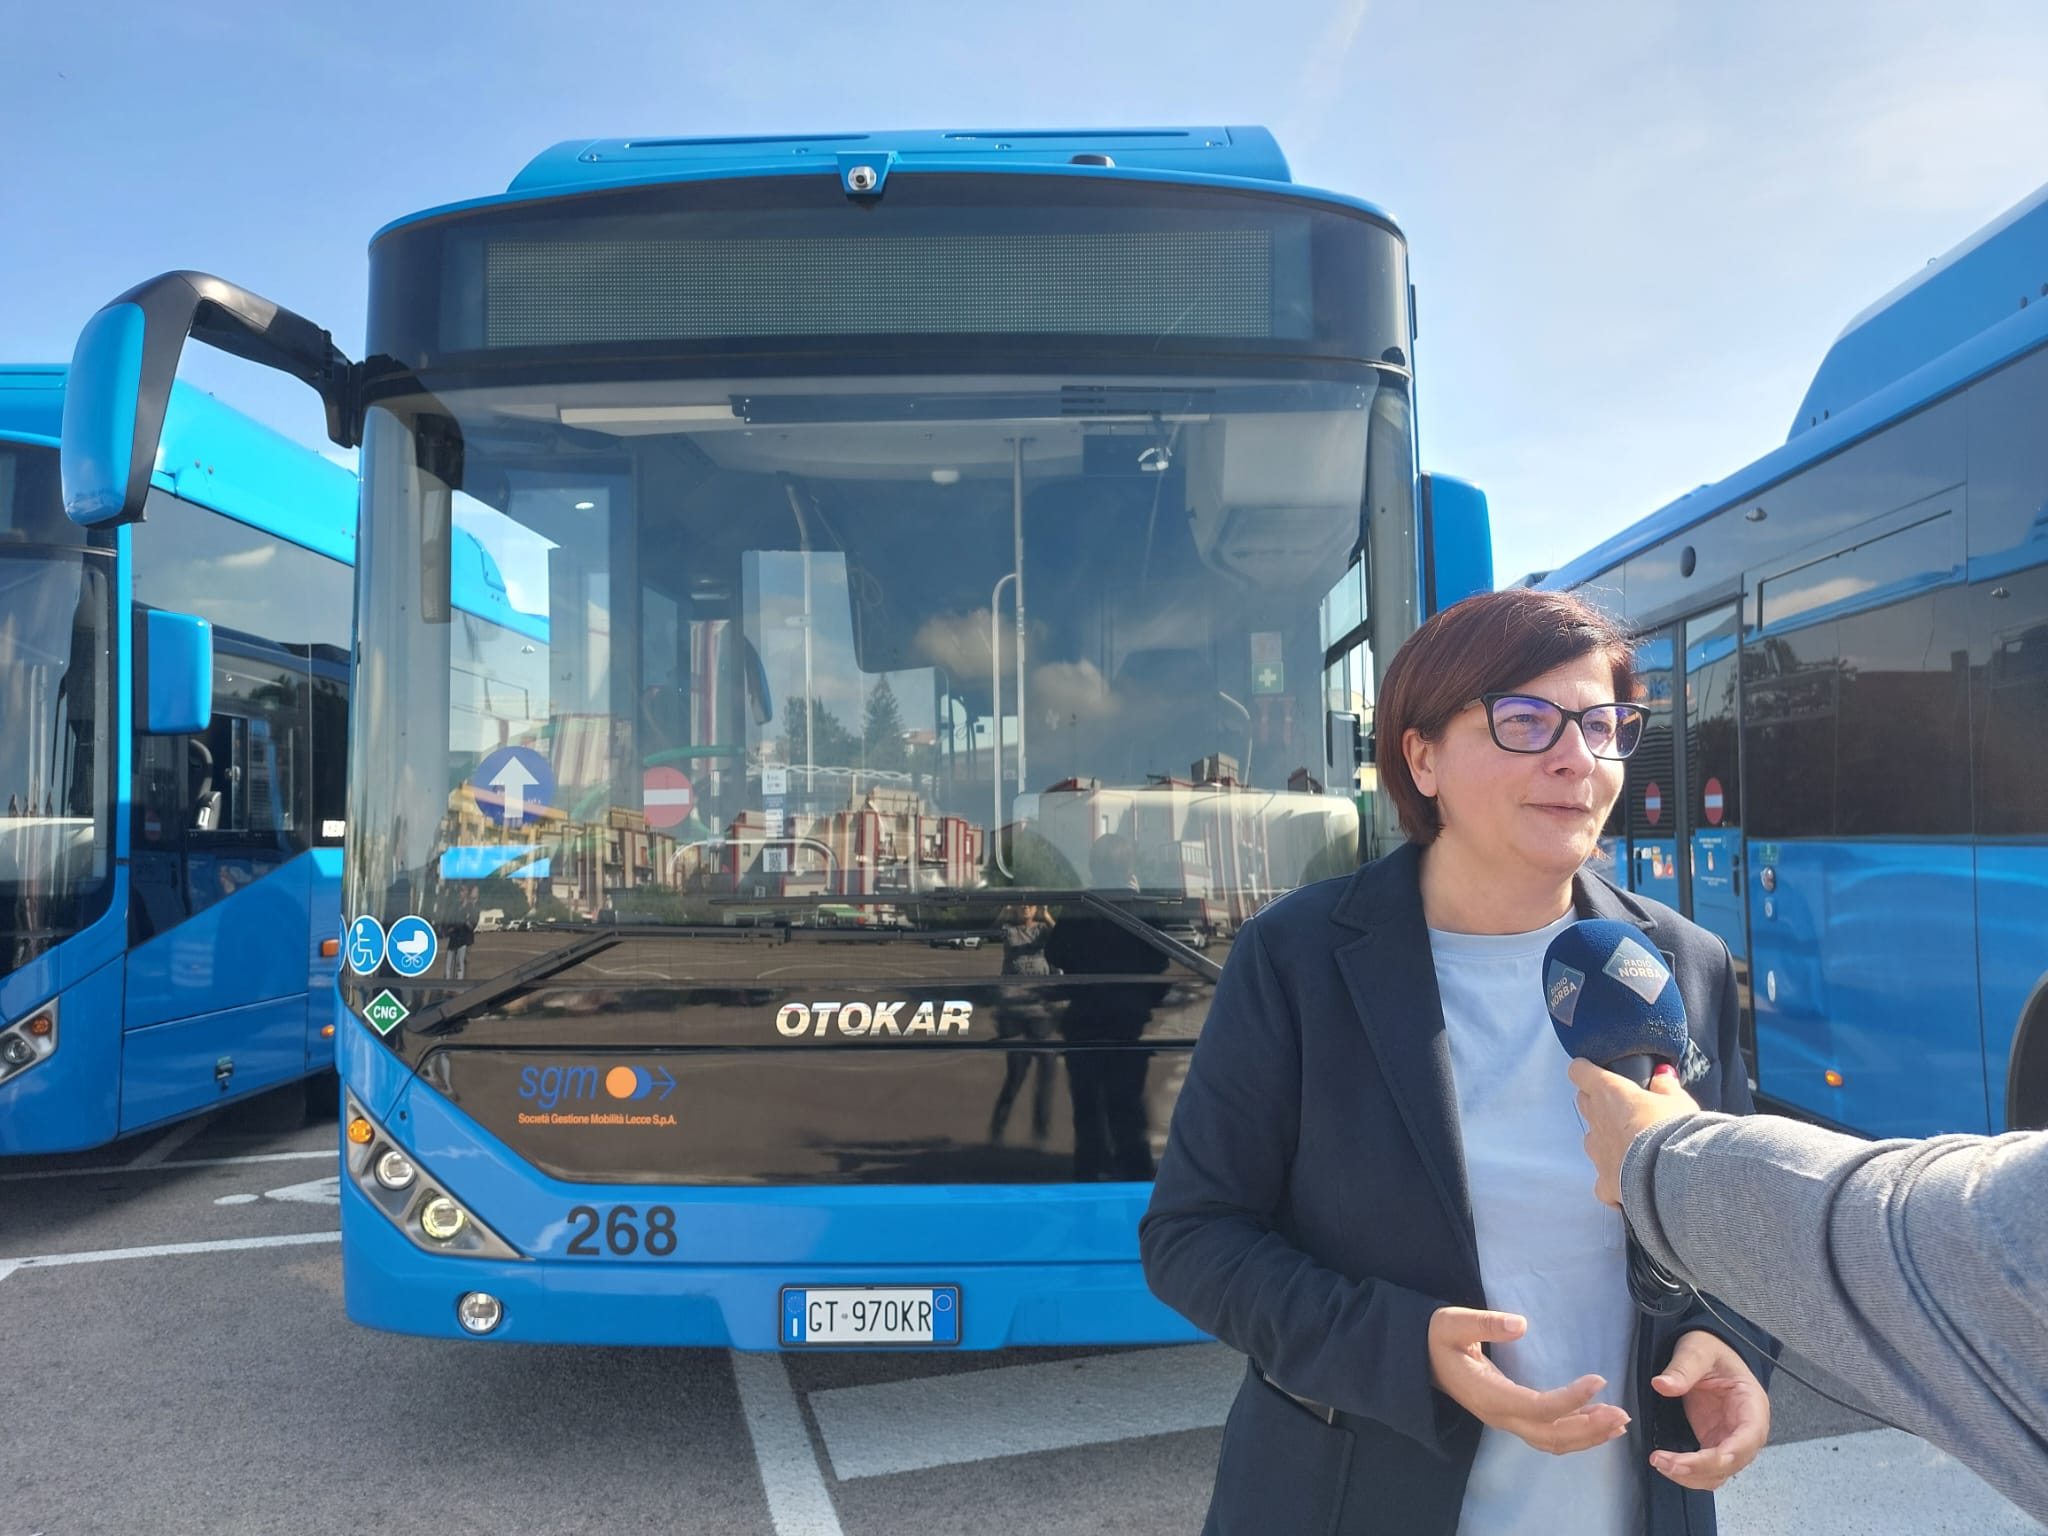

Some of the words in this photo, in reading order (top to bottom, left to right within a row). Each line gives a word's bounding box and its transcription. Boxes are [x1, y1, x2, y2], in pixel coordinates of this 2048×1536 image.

[1618, 966, 1662, 979] NORBA
[1623, 959, 1652, 968] RADIO
[1551, 981, 1577, 1011] NORBA
[373, 1005, 397, 1019] CNG
[775, 1001, 973, 1037] OTOKAR
[518, 1065, 598, 1110] sgm
[518, 1112, 550, 1124] Società
[551, 1113, 590, 1124] Gestione
[590, 1113, 624, 1125] Mobilità
[625, 1113, 652, 1125] Lecce
[652, 1113, 677, 1127] S.p.A.
[566, 1204, 677, 1256] 268
[808, 1300, 838, 1332] GT
[852, 1300, 932, 1332] 970KR
